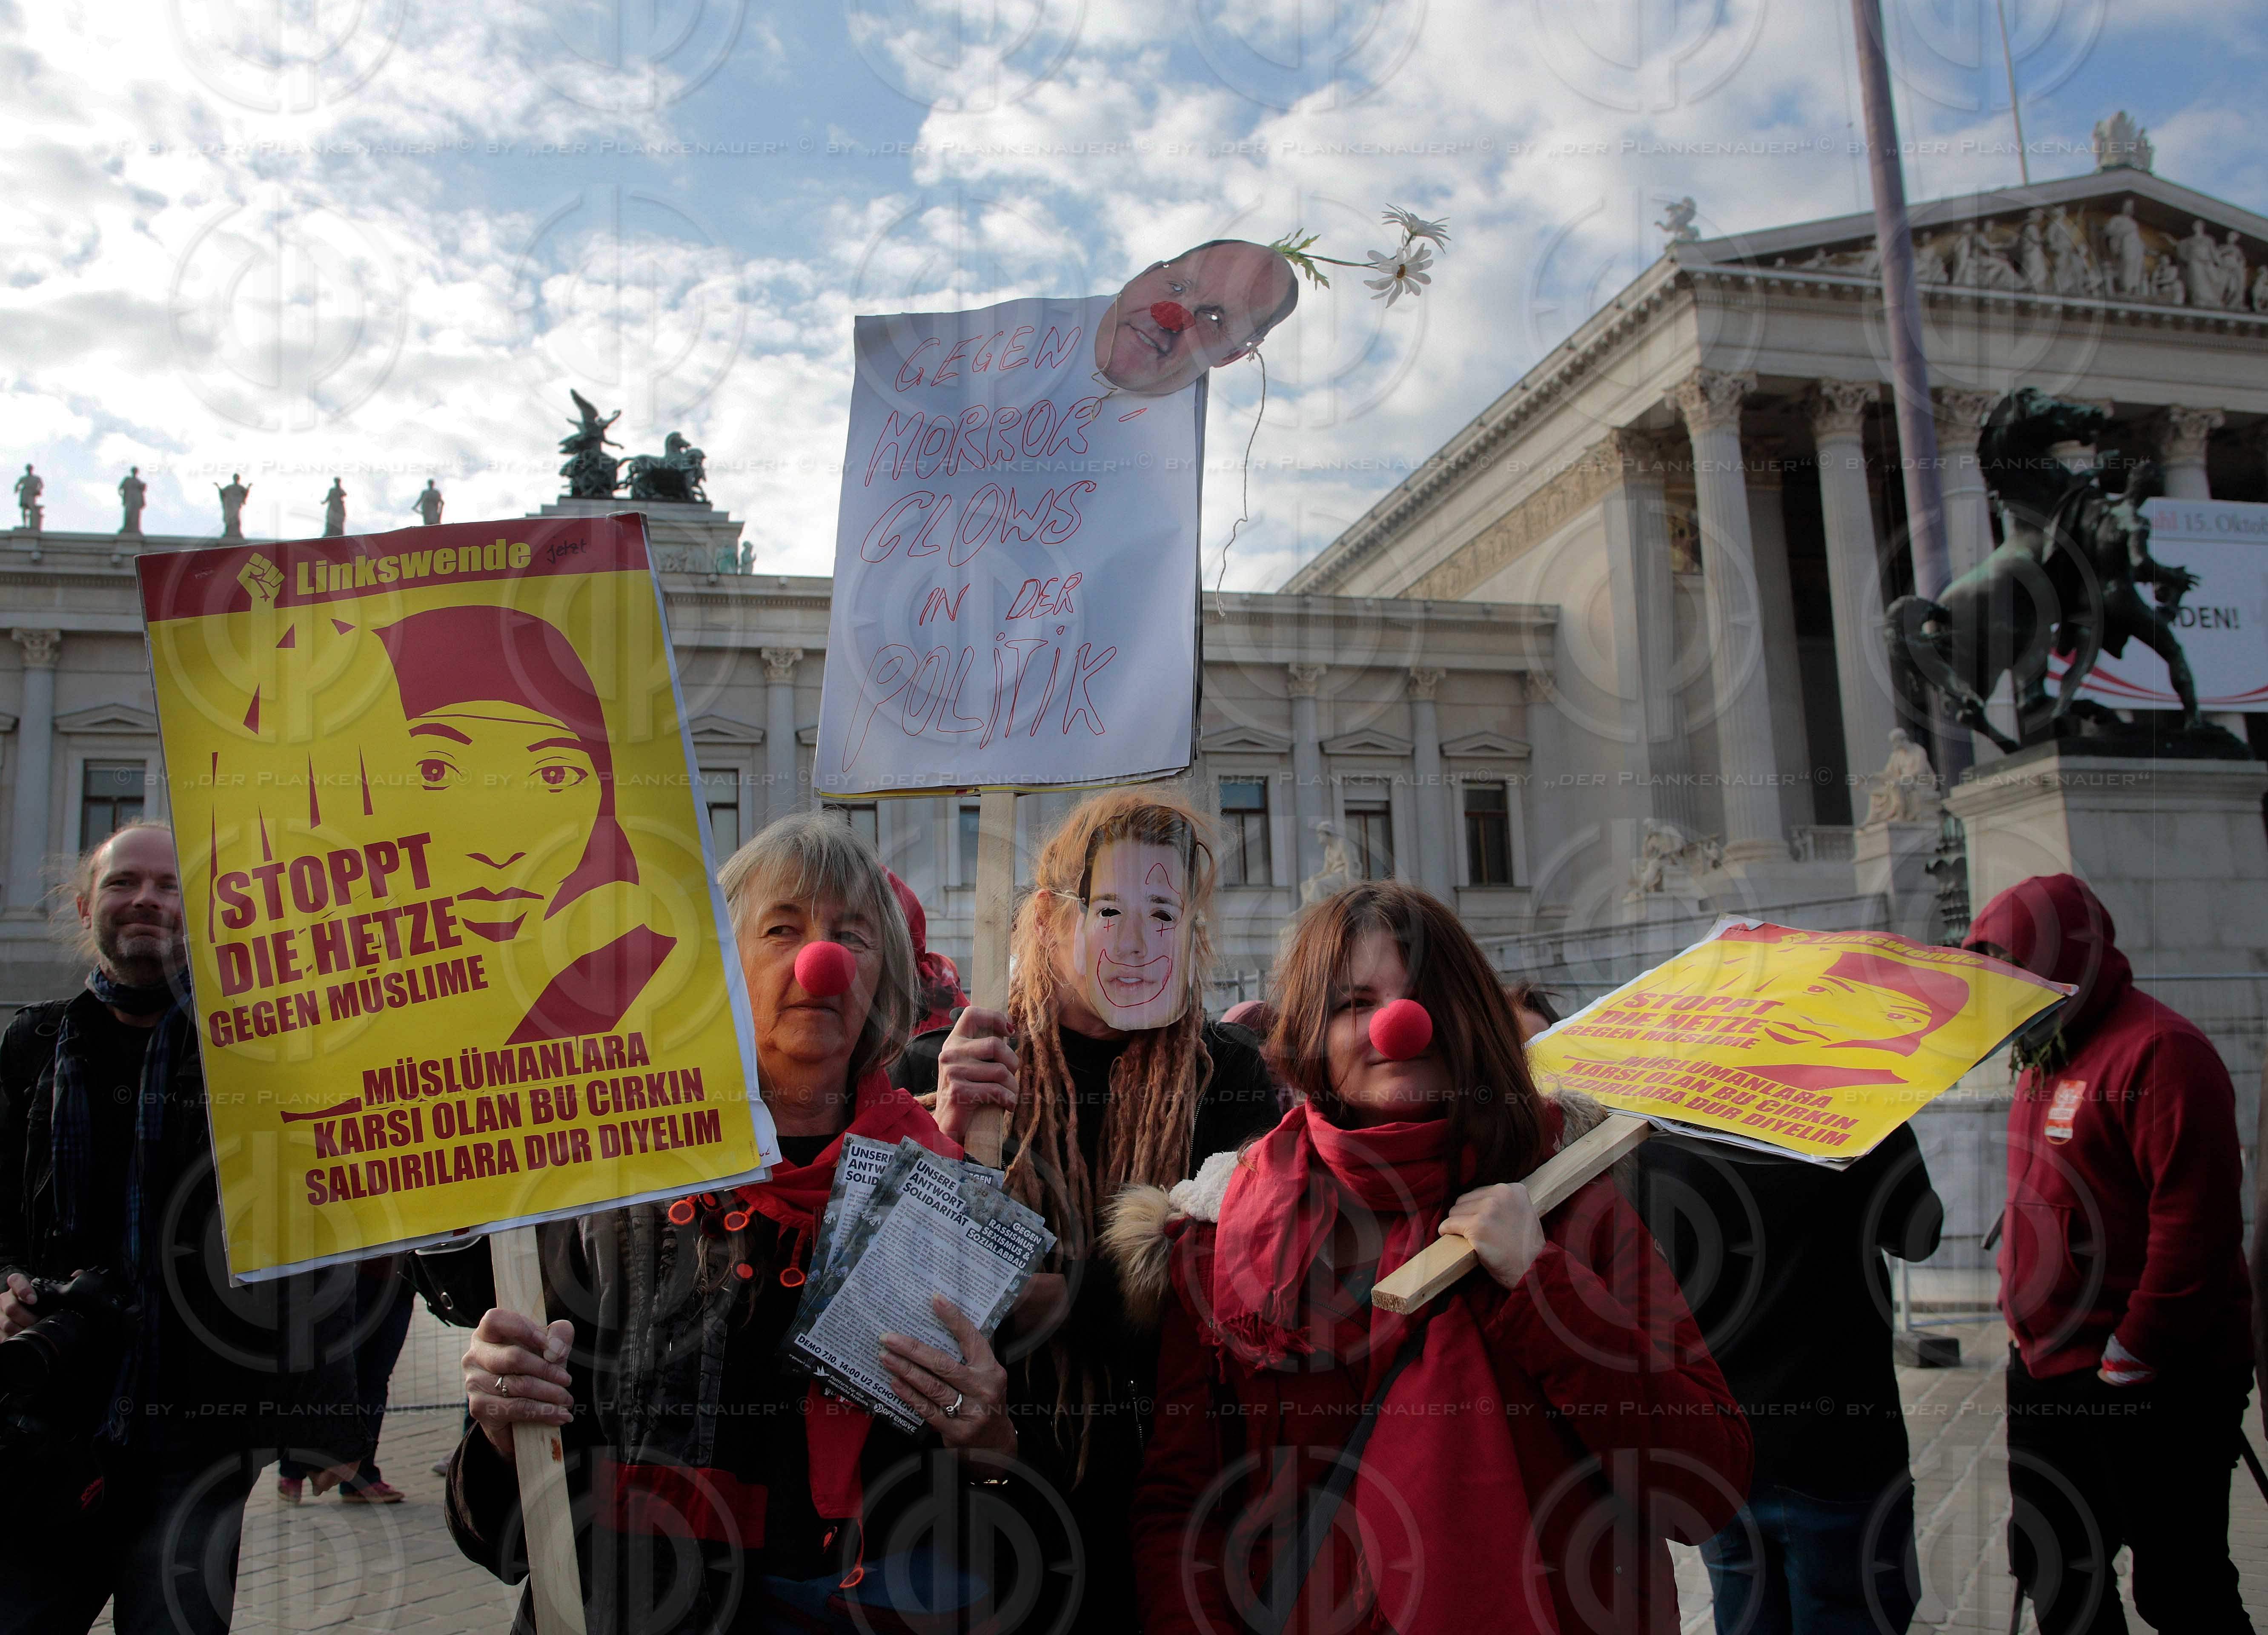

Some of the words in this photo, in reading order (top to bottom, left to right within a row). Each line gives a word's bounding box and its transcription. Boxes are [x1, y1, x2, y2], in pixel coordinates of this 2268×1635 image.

[895, 326, 1081, 392] GEGEN
[297, 539, 531, 595] Linkswende
[547, 536, 587, 564] jetzt
[919, 583, 971, 626] IN
[1005, 572, 1082, 620] DER
[216, 832, 431, 929] STOPPT
[215, 929, 303, 997] DIE
[310, 896, 463, 975] HETZE
[1811, 935, 1984, 966] Linkswende
[209, 990, 321, 1047] GEGEN
[1592, 1010, 1658, 1026] DIE
[1655, 1013, 1770, 1034] HETZE
[1624, 993, 1785, 1015] STOPPT
[1562, 1025, 1642, 1039] GEGEN
[362, 1032, 650, 1107] MÜSLÜMANLARA
[1618, 1056, 1833, 1108] MÜSLÜMANLARA
[313, 1107, 424, 1159] KARSI
[431, 1094, 522, 1139] OLAN
[528, 1079, 578, 1125] BU
[587, 1067, 704, 1116] CIRKIN
[1564, 1062, 1647, 1081] KARSI
[1644, 1072, 1716, 1093] OLAN
[1710, 1086, 1758, 1105] BU
[1755, 1100, 1859, 1130] CIRKIN
[1684, 1096, 1743, 1120] DUR
[1740, 1113, 1852, 1146] DIYELIM
[305, 1138, 519, 1206] SALDIRILARA
[524, 1127, 592, 1170] DUR
[598, 1109, 722, 1159] DIYELIM
[917, 1161, 956, 1190] UNSERE
[903, 1182, 969, 1227] SOLIDARITÄT
[909, 1173, 964, 1209] ANTWORT
[967, 1229, 1026, 1269] SOZIALABBAU
[982, 1227, 1022, 1258] SEXISMUS
[988, 1219, 1035, 1254] RASSISMUS,
[1012, 1222, 1042, 1245] GEGEN
[798, 1335, 822, 1354] DEMO
[839, 1362, 859, 1378] 14:00
[860, 1375, 873, 1386] U2
